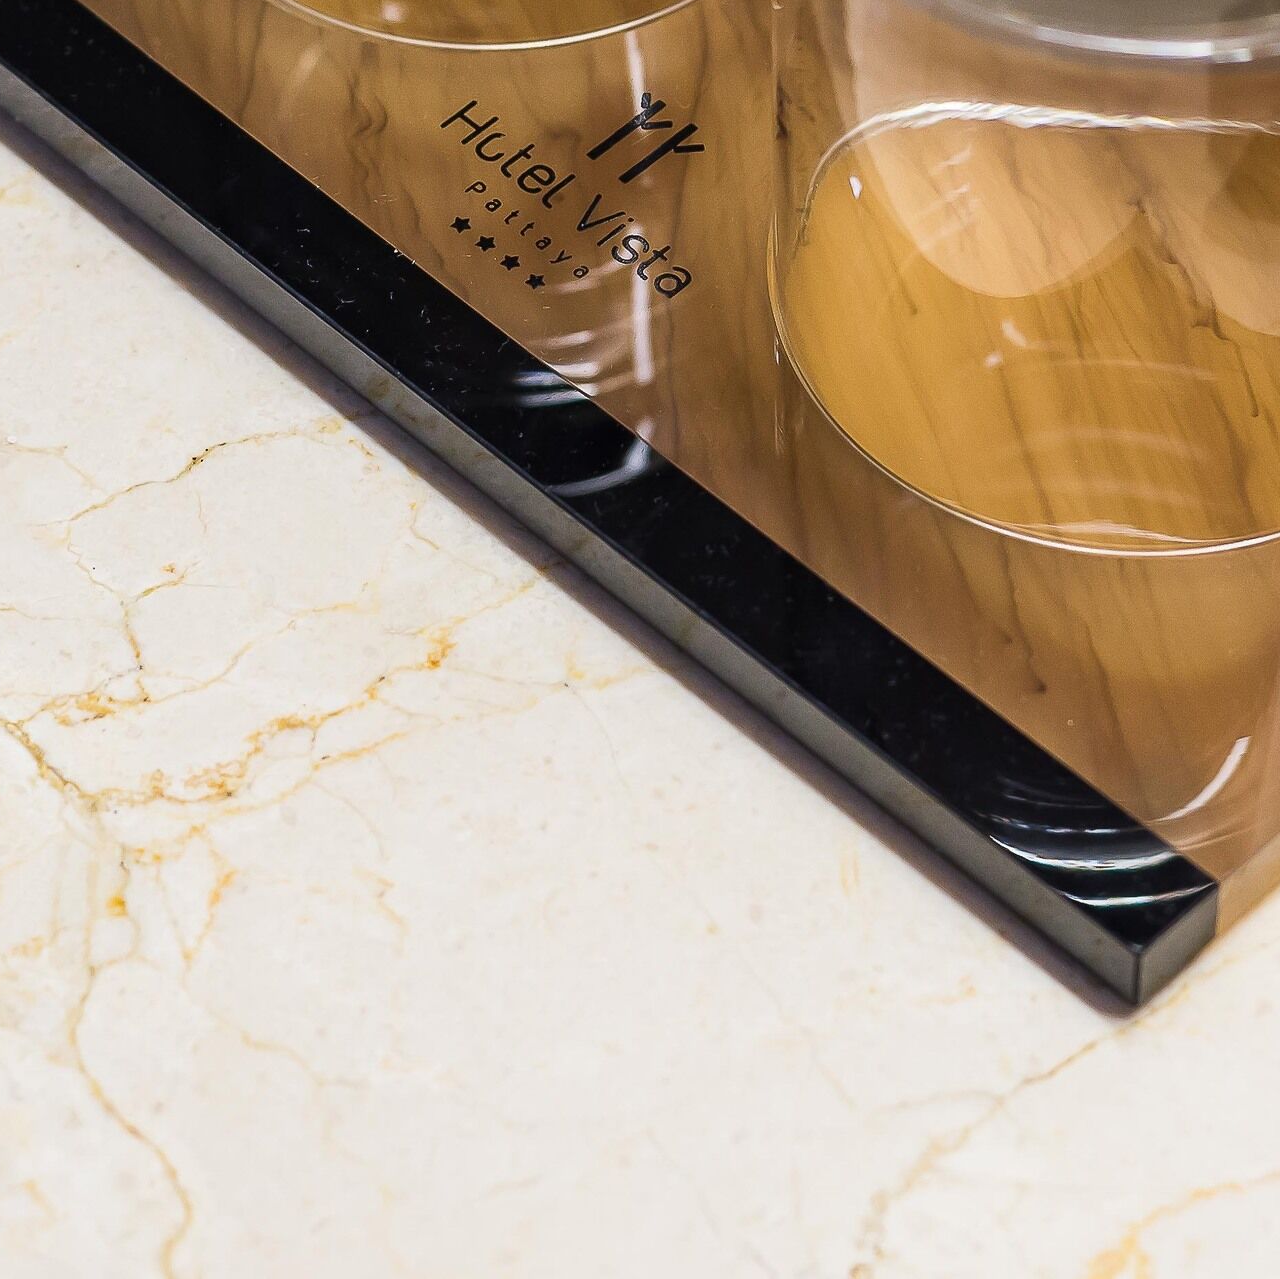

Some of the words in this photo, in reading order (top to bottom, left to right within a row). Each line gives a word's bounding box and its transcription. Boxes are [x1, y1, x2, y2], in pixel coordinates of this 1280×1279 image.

[439, 99, 577, 209] Hotel
[576, 193, 693, 299] Vista
[464, 180, 590, 280] Pattaya
